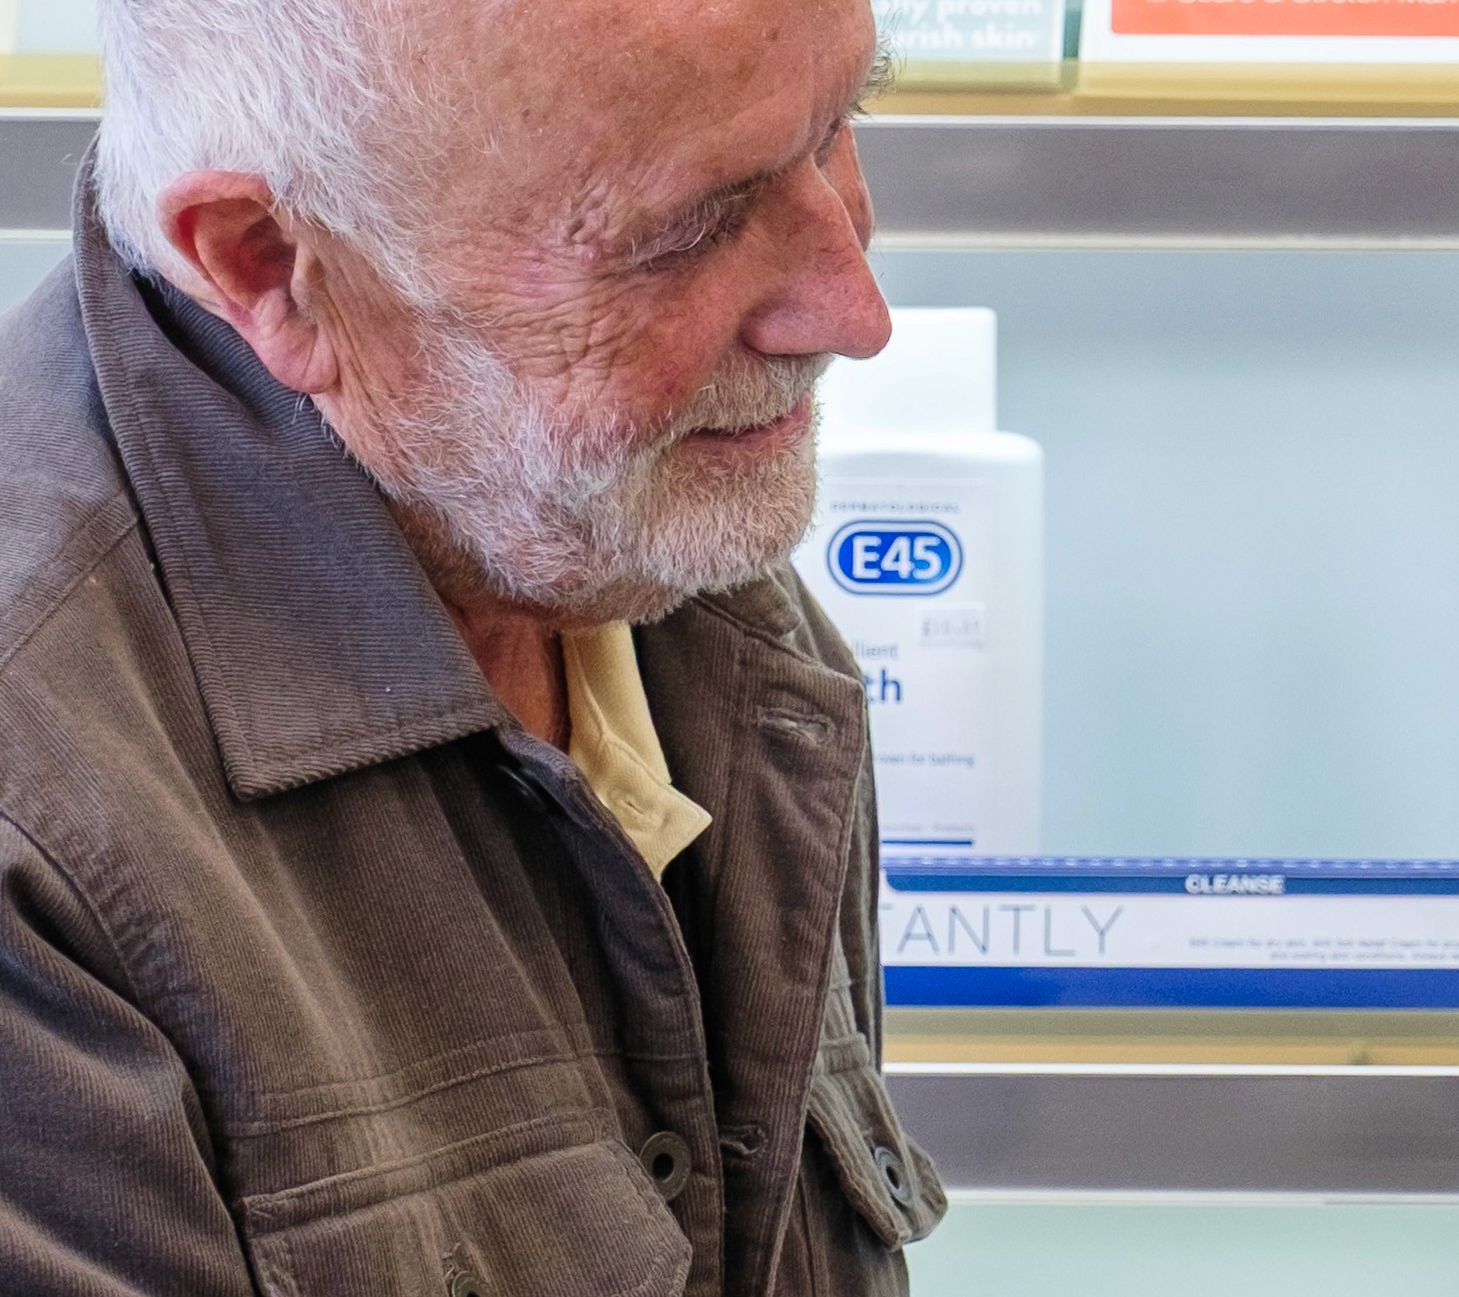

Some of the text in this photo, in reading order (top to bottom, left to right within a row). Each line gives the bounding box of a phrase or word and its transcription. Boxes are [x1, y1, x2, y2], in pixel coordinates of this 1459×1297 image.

[852, 535, 943, 581] E45
[1185, 873, 1286, 896] CLEANSE
[894, 905, 1124, 958] ANTLY
